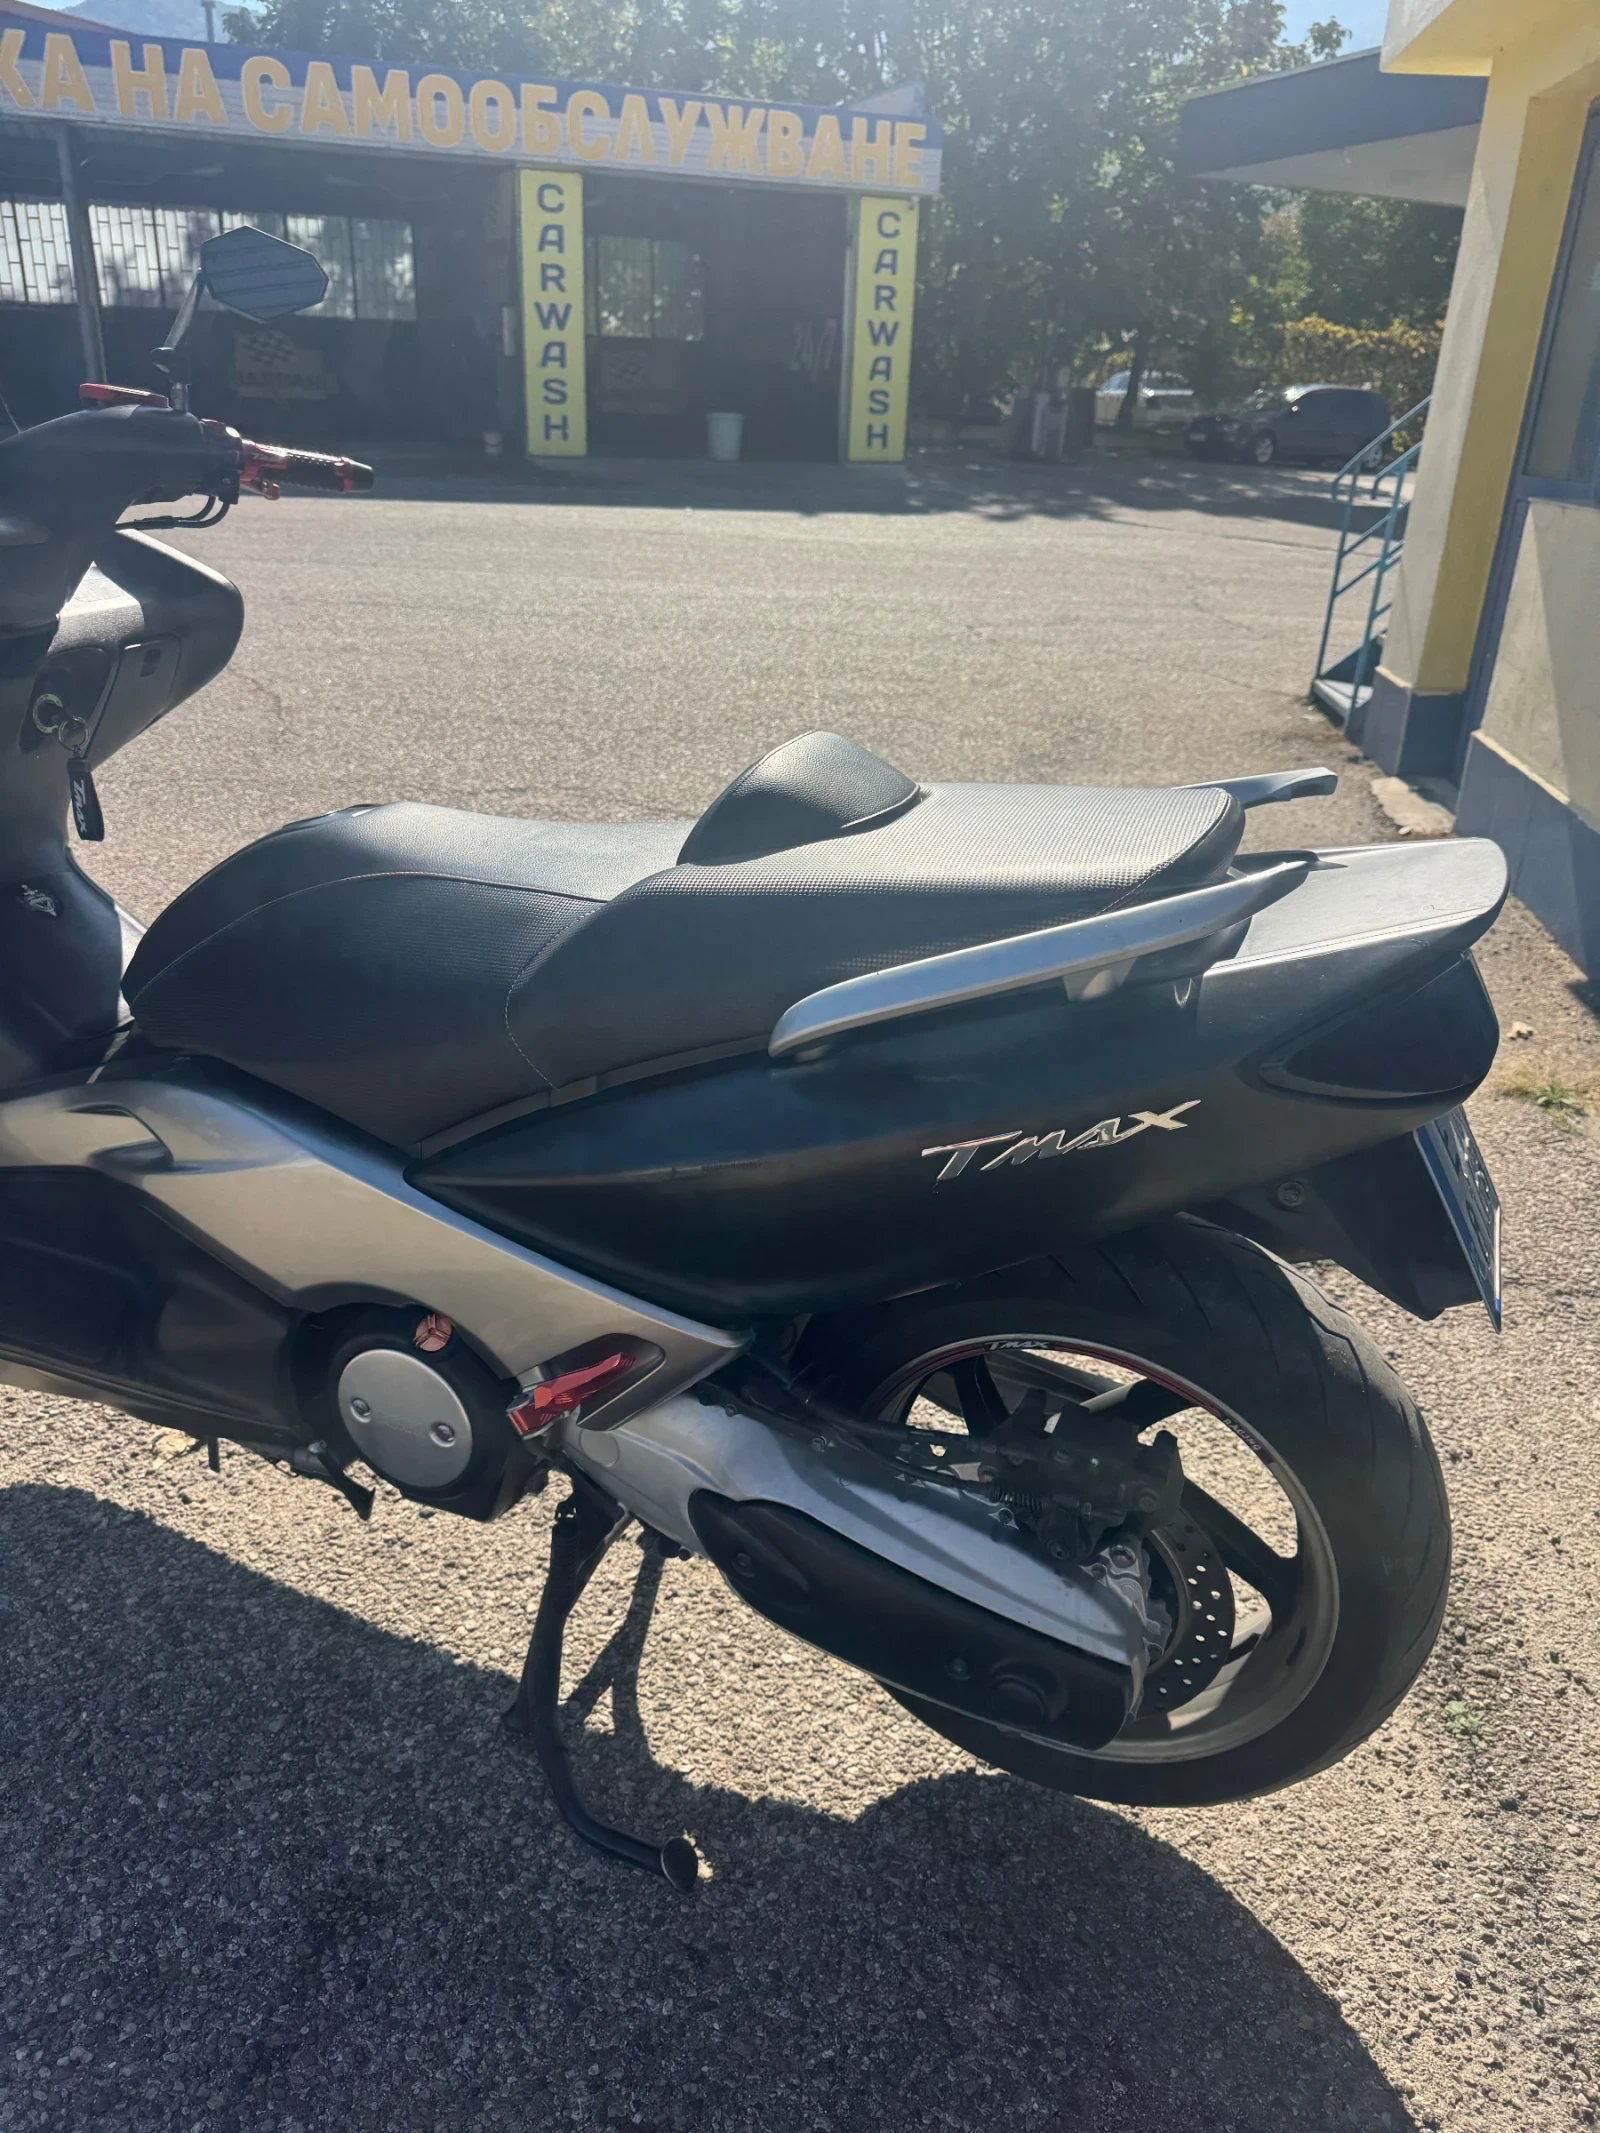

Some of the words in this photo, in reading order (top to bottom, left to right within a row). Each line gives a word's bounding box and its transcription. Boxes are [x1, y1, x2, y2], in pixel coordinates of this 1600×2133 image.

[110, 39, 227, 125] НА
[241, 55, 927, 188] САМООБСЛУЖВАНЕ
[533, 183, 572, 442] CARWASH
[865, 211, 901, 450] CARWASH
[921, 1098, 1202, 1181] TMAX
[984, 1340, 1049, 1351] TMAX
[1222, 1418, 1262, 1451] RACING
